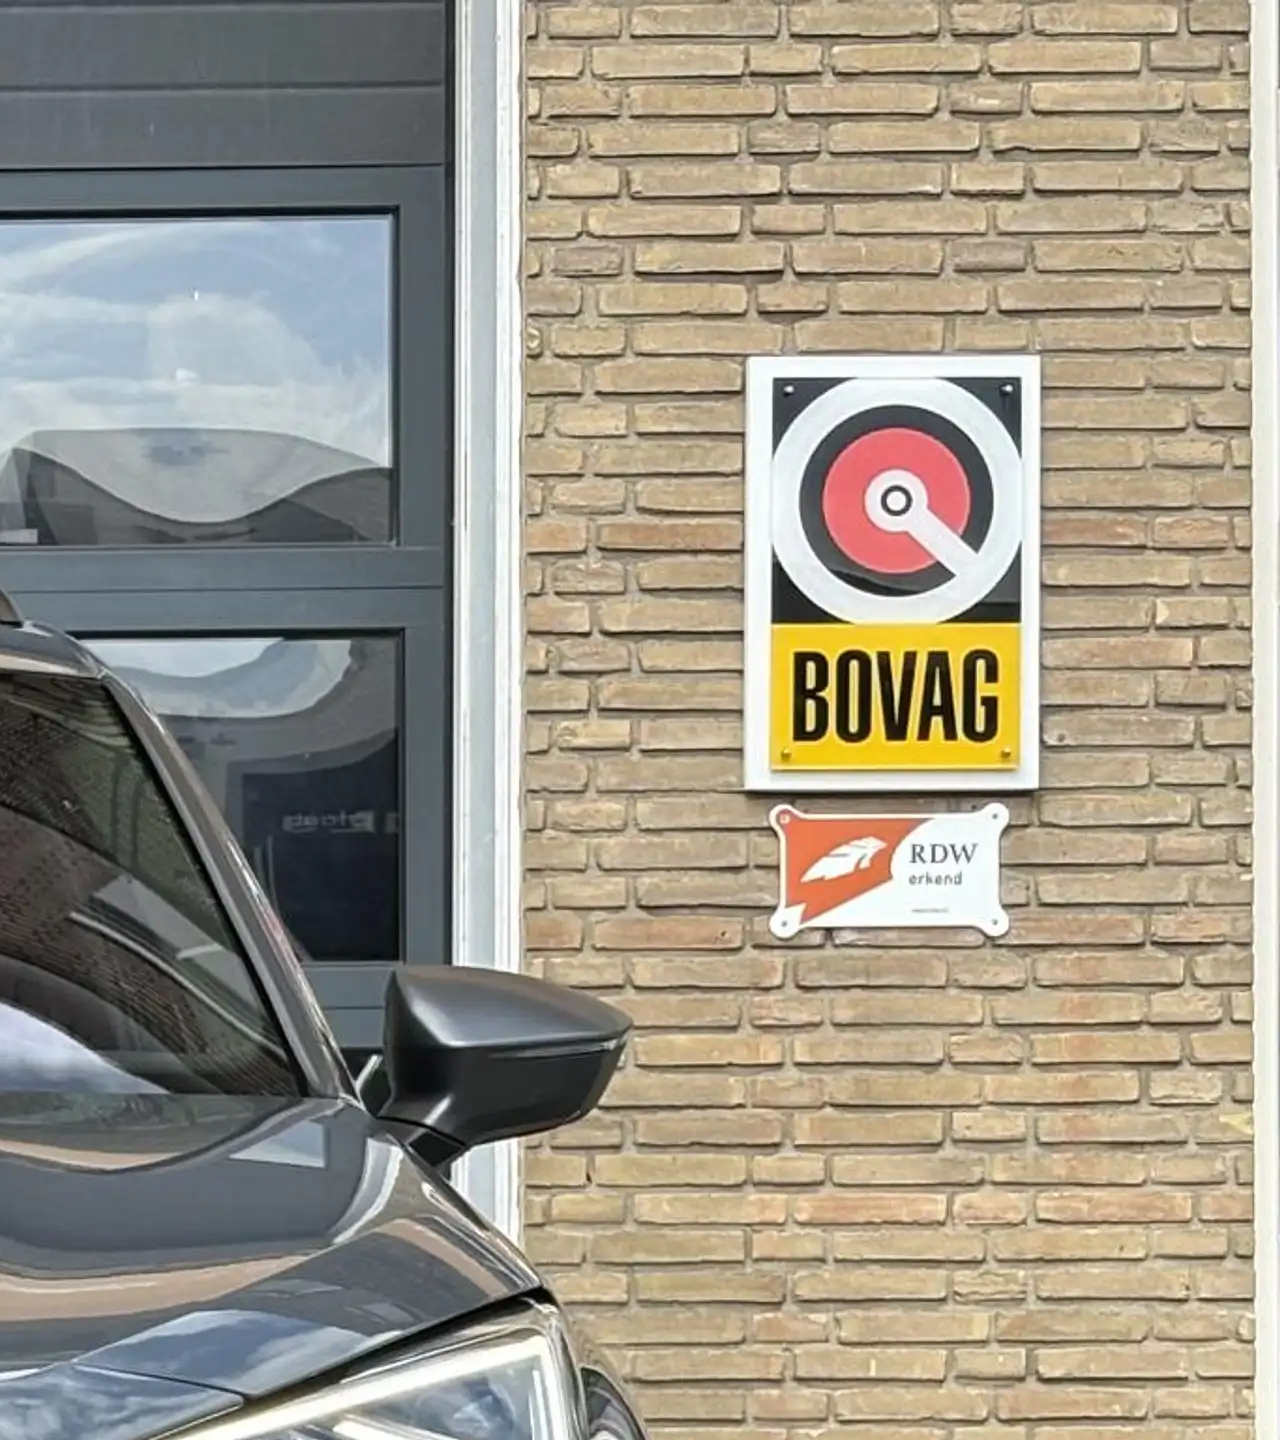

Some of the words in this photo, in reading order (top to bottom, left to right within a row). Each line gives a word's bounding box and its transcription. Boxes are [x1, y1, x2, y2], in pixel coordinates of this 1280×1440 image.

[792, 650, 999, 743] BOVAG
[909, 843, 979, 865] RDW
[908, 870, 962, 886] erkend
